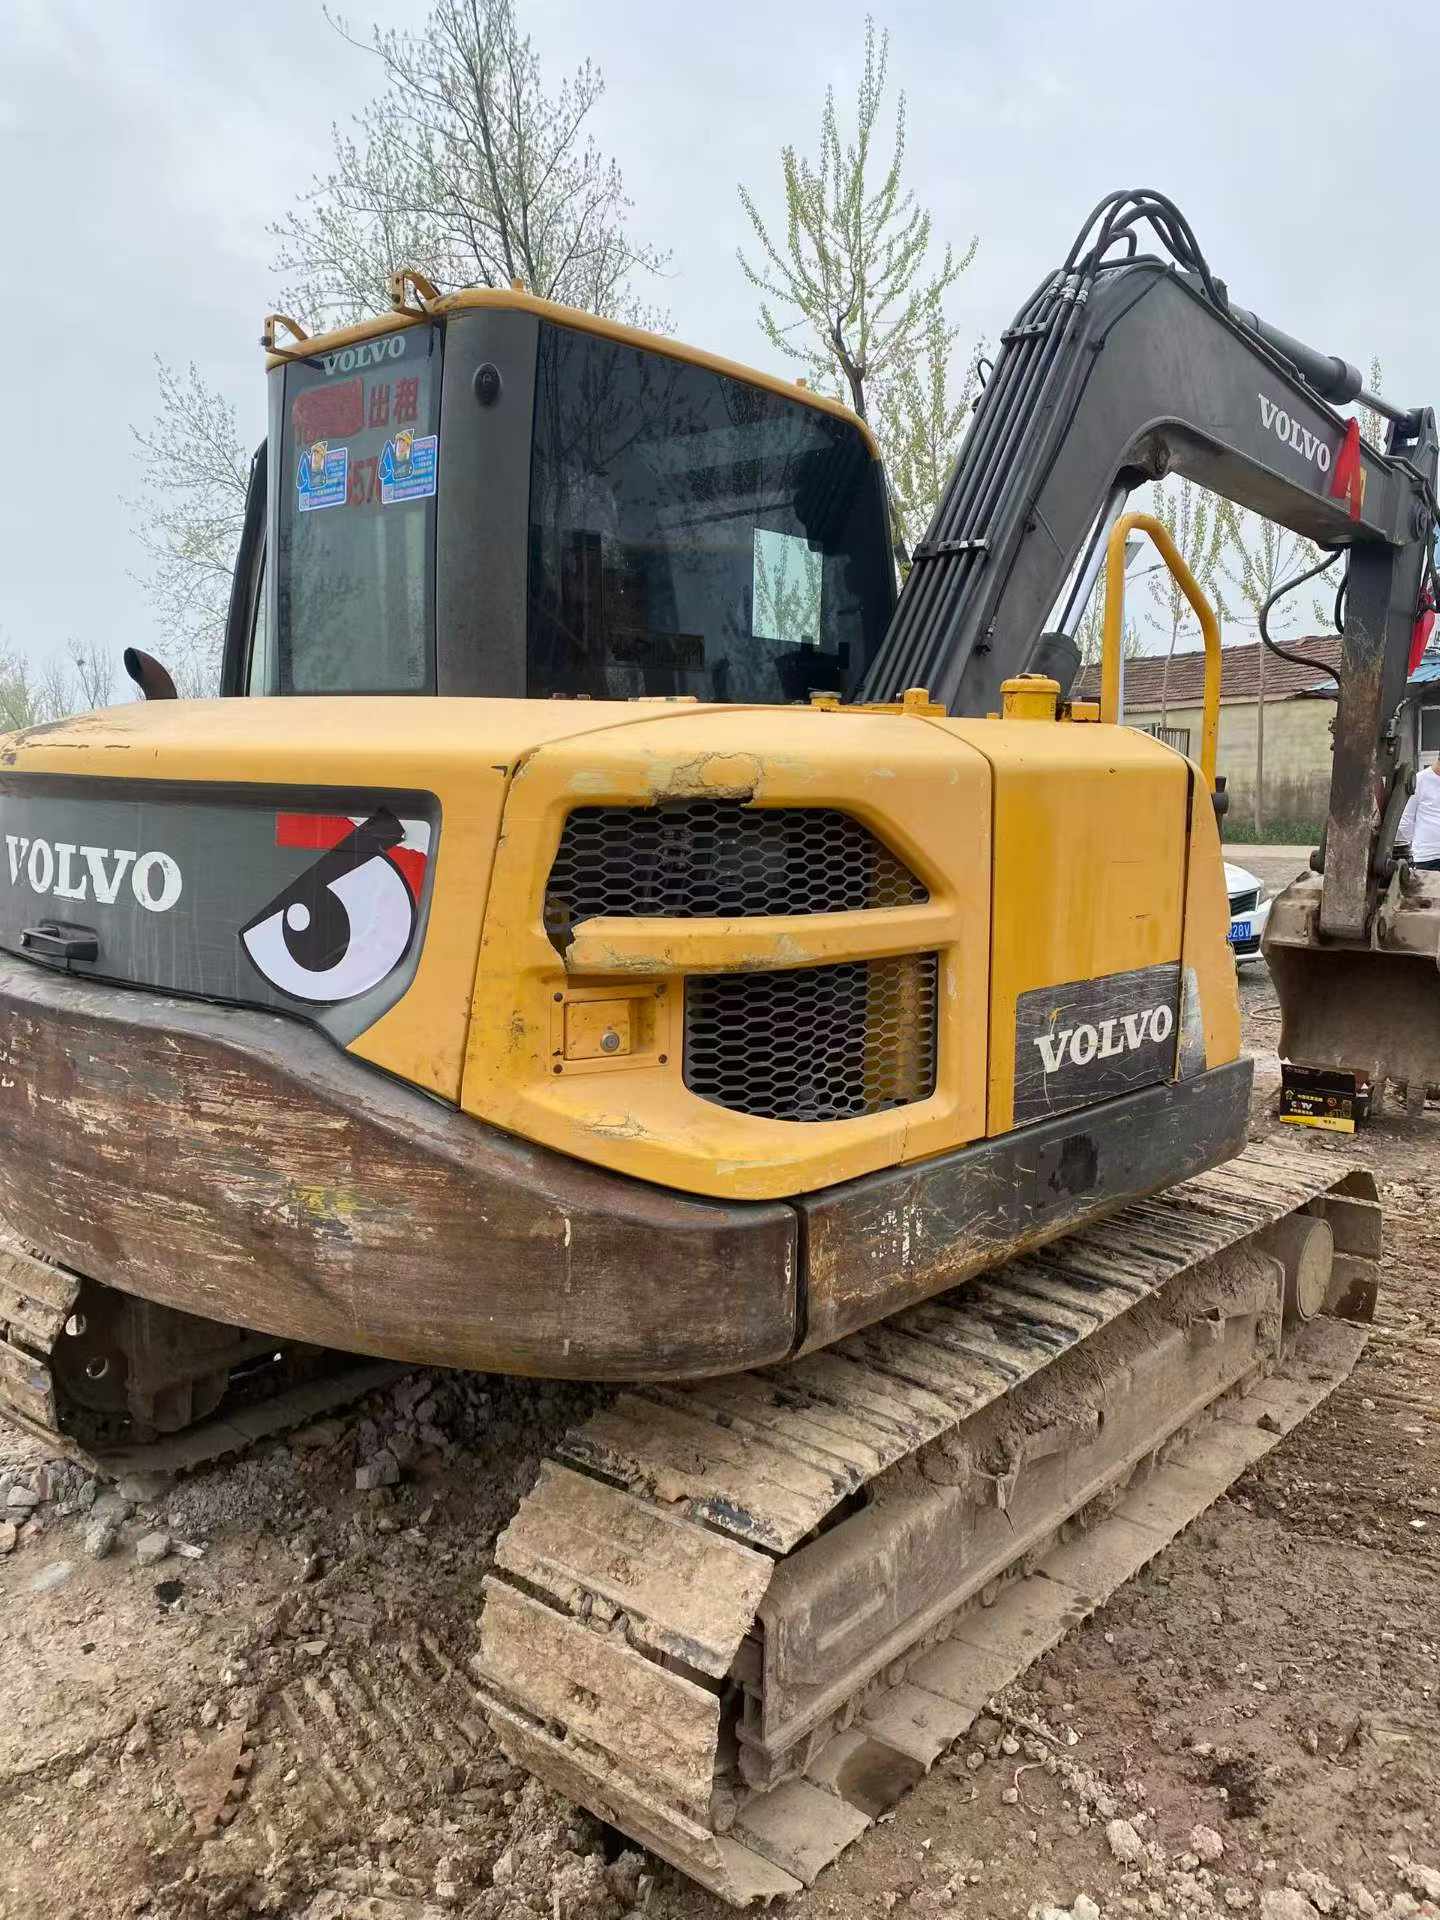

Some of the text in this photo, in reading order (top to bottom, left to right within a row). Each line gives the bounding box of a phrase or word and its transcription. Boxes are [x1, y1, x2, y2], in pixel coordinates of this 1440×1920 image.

[323, 336, 406, 375] VOLVO
[369, 377, 419, 428] 出租
[1258, 393, 1331, 472] VOLVO
[6, 835, 183, 912] VOLVO
[1034, 1004, 1173, 1073] VOLVO
